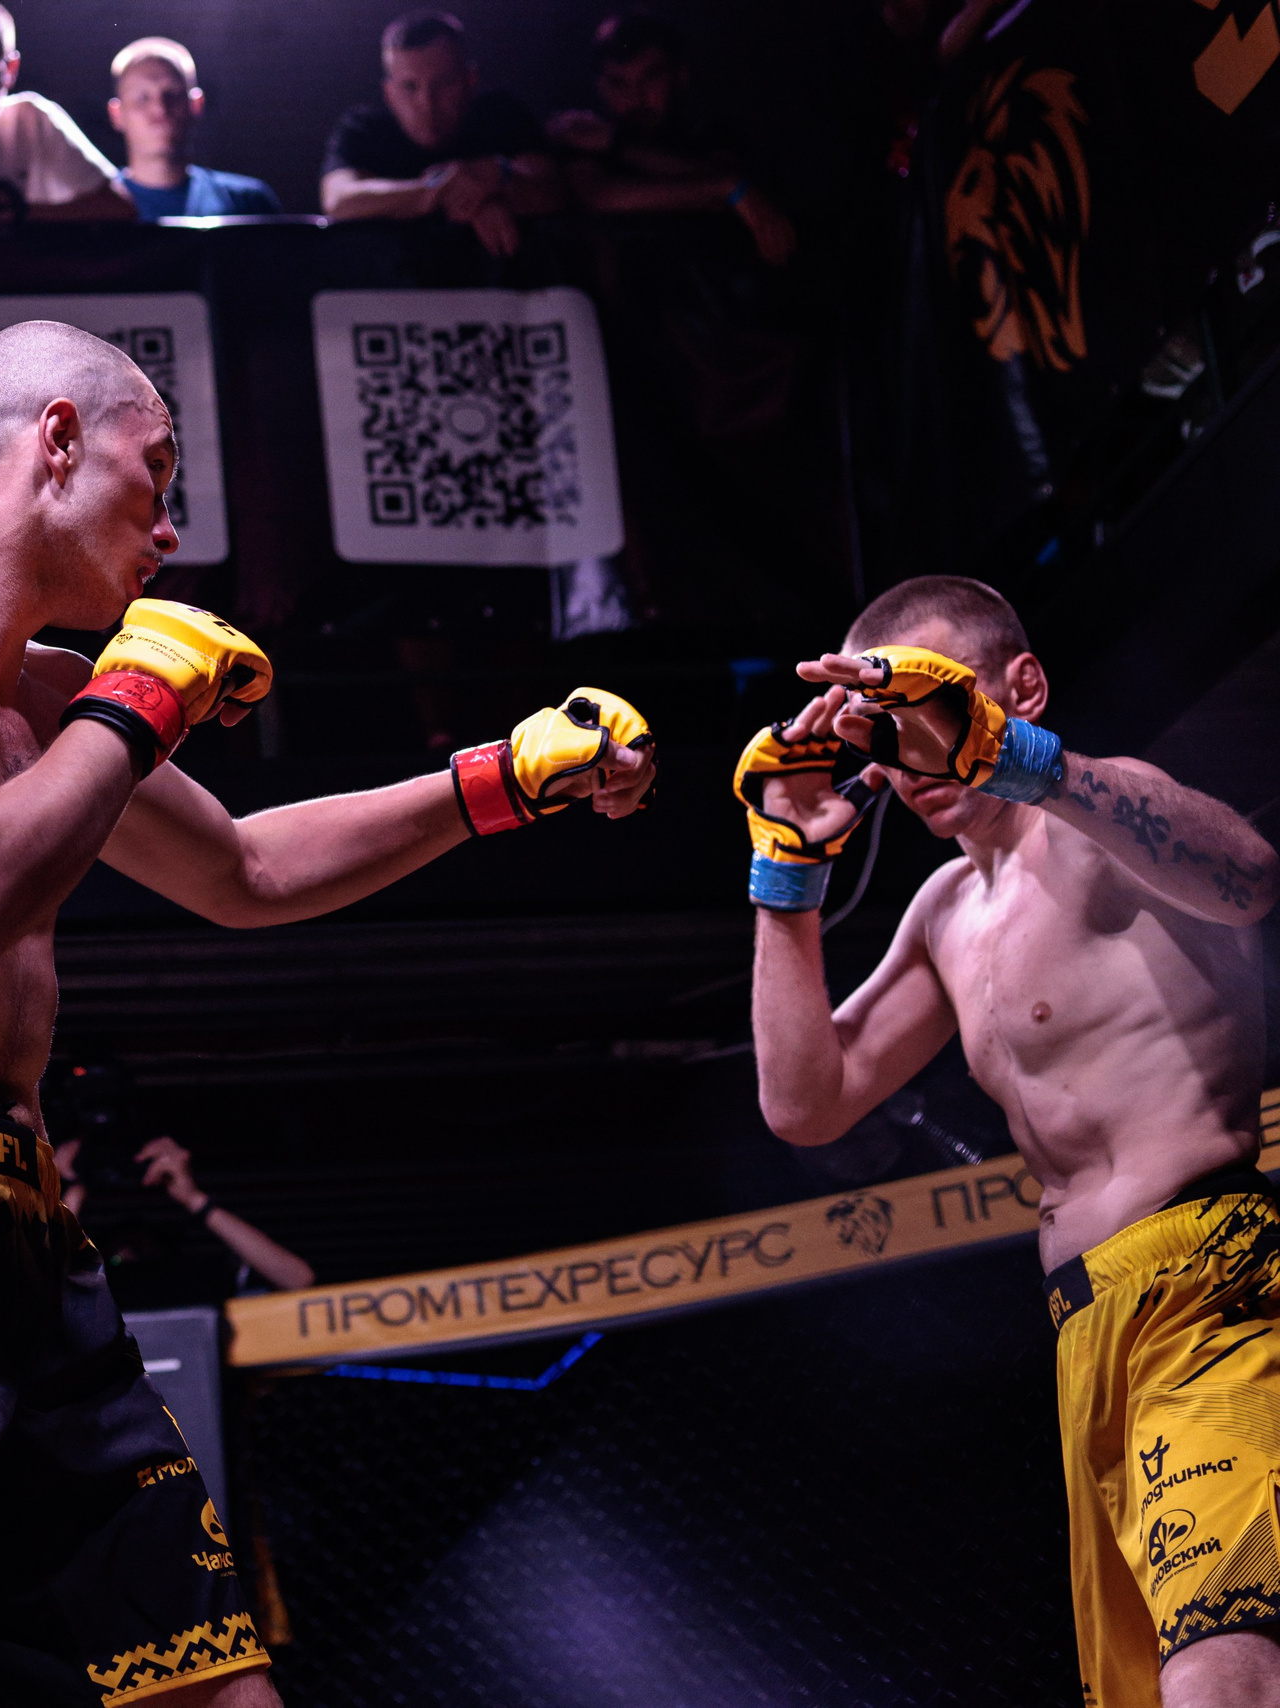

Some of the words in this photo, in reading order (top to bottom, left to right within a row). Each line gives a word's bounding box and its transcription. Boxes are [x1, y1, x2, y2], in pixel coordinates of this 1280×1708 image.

[137, 636, 168, 650] SIBERIAN
[169, 648, 199, 673] FIGHTING
[150, 645, 177, 663] LEAGUE
[298, 1222, 795, 1338] ПРОМТЕХРЕСУРС
[1139, 1457, 1233, 1544] лодчинка
